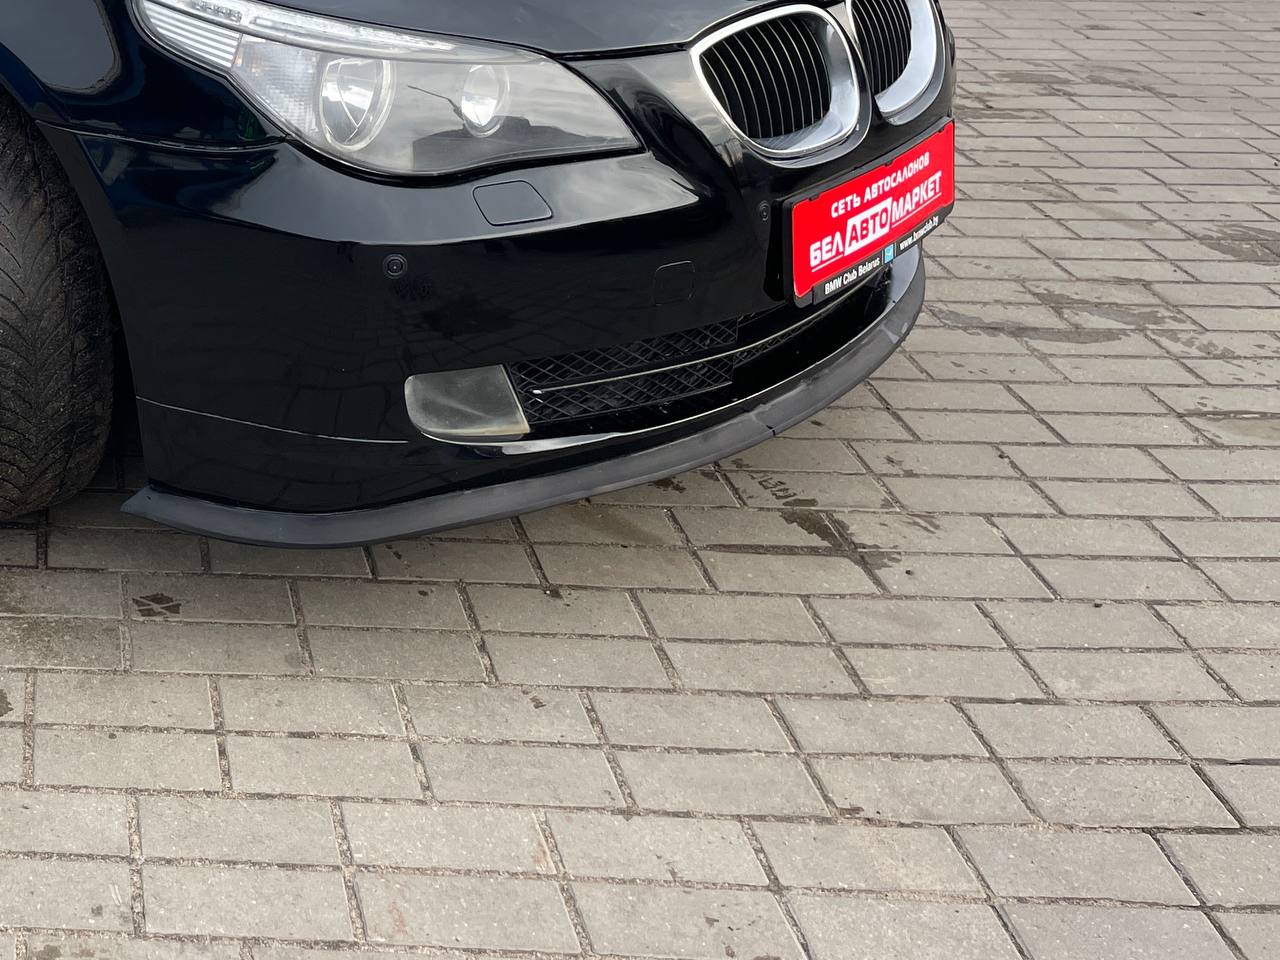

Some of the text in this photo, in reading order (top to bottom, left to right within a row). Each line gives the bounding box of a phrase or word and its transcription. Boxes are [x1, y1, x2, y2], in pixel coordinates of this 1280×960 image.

[831, 152, 930, 218] СЕТЬ АВТОСАЛОНОВ
[824, 275, 843, 295] BMW
[842, 268, 858, 285] Club
[858, 257, 880, 277] Belarus
